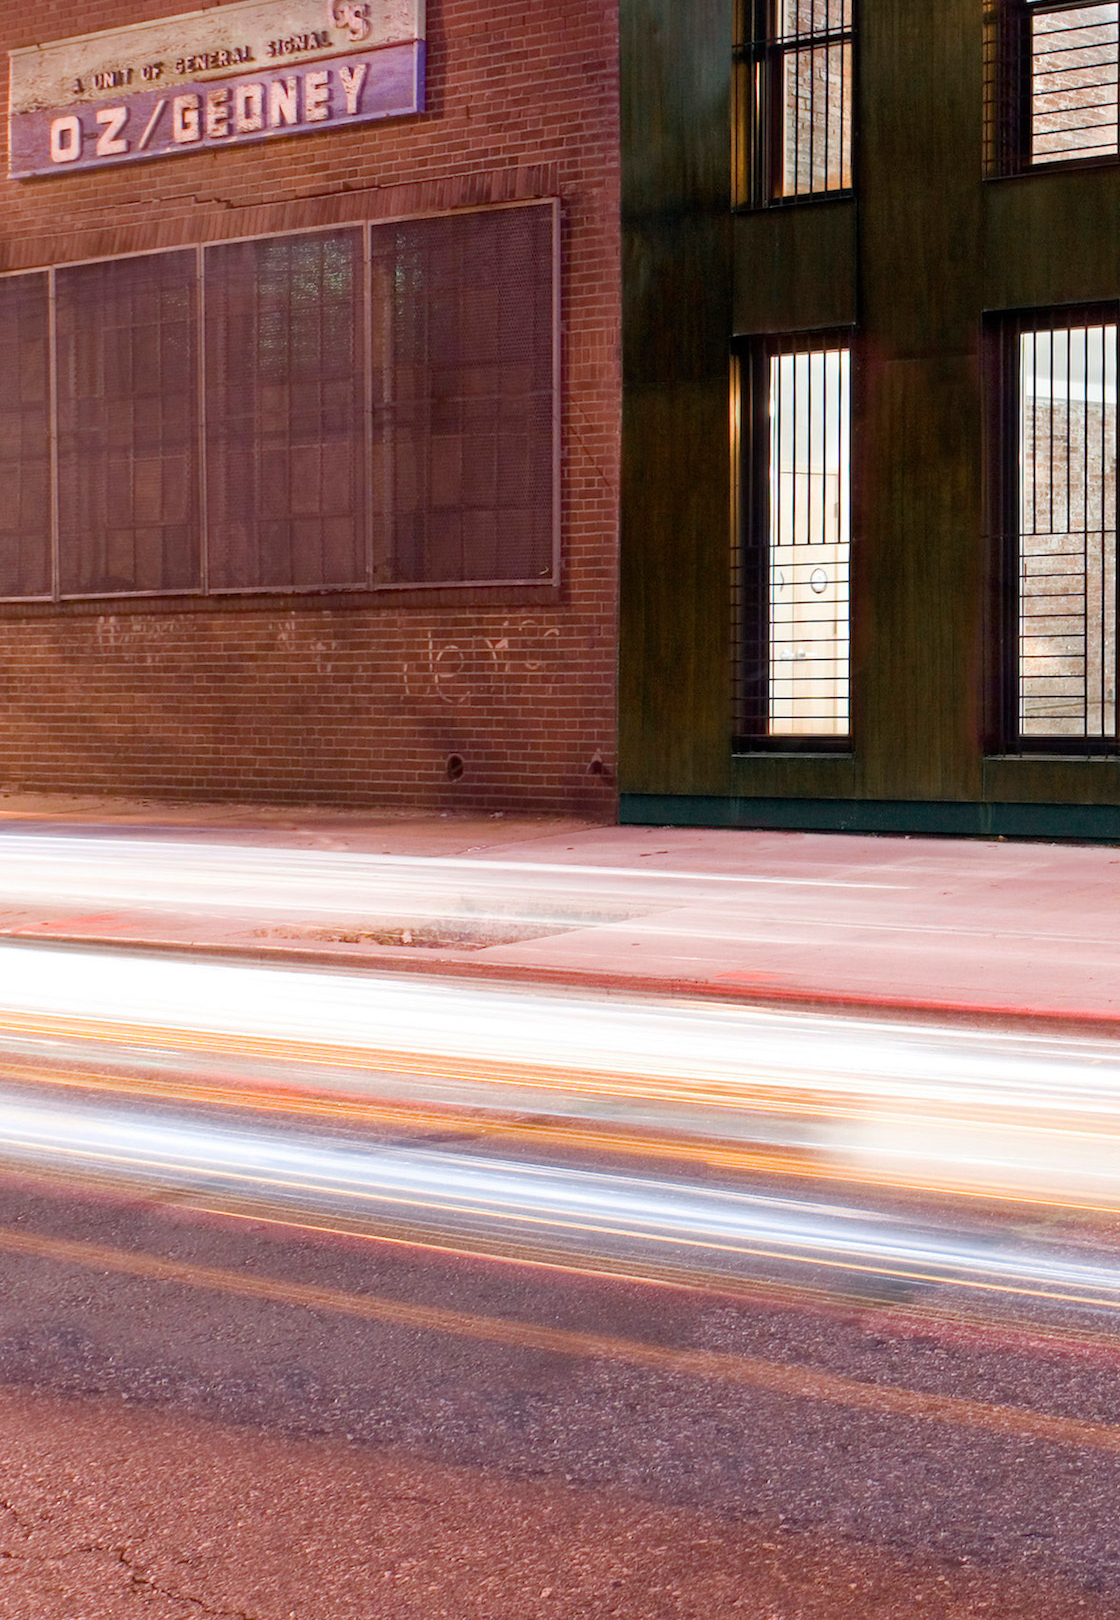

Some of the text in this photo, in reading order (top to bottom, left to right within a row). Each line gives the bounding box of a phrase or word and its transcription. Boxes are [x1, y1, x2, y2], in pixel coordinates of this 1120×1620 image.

[93, 68, 132, 90] UNIT
[141, 62, 164, 80] OF
[175, 45, 255, 74] GENERAL
[267, 31, 332, 57] SIGNAL
